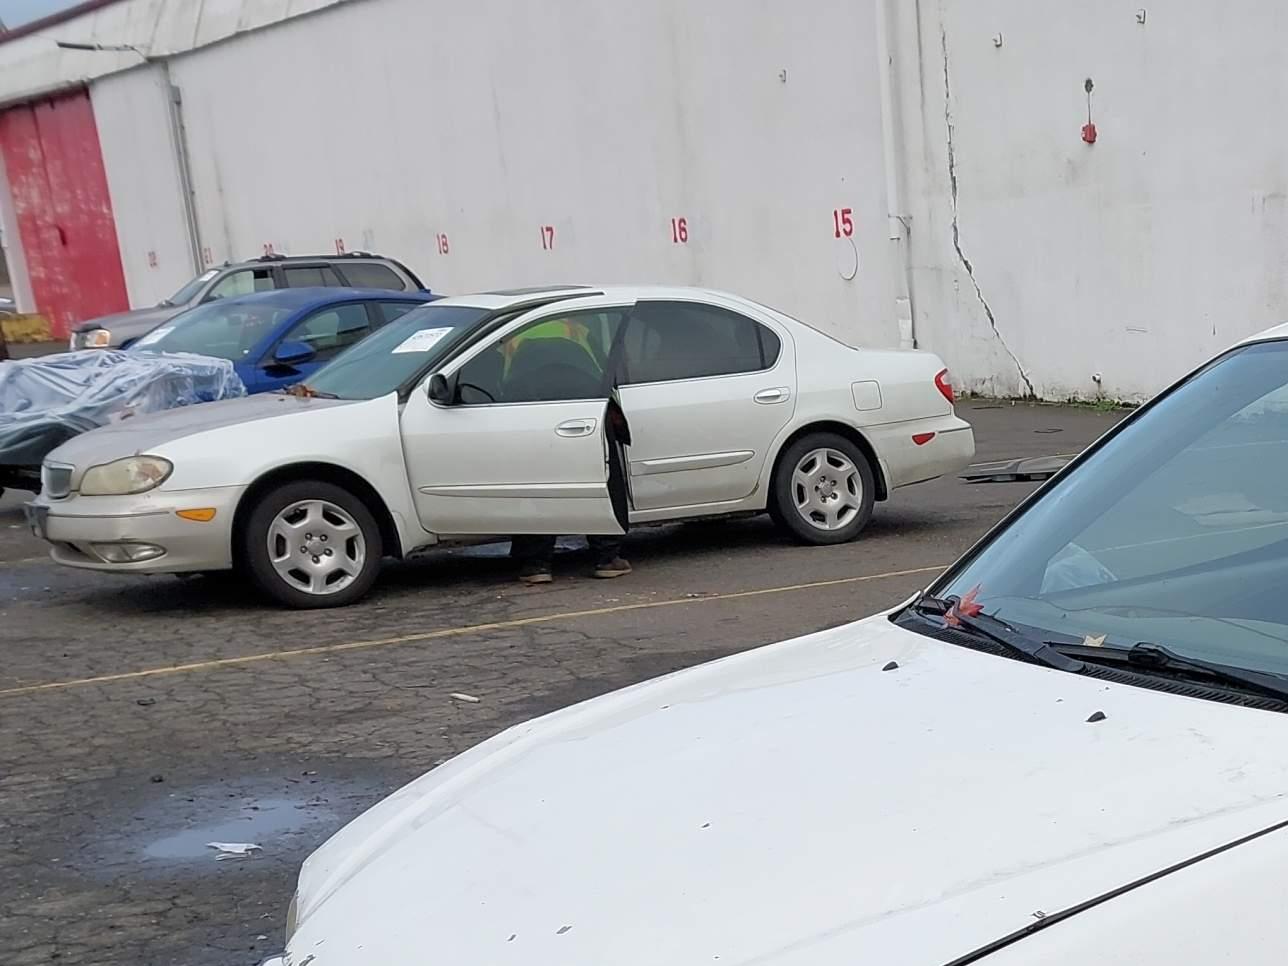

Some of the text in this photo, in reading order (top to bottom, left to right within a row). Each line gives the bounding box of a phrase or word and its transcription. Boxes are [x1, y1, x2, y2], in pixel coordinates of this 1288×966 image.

[671, 217, 688, 243] 16
[833, 208, 853, 238] 15
[436, 233, 449, 255] 18
[541, 226, 554, 250] 17
